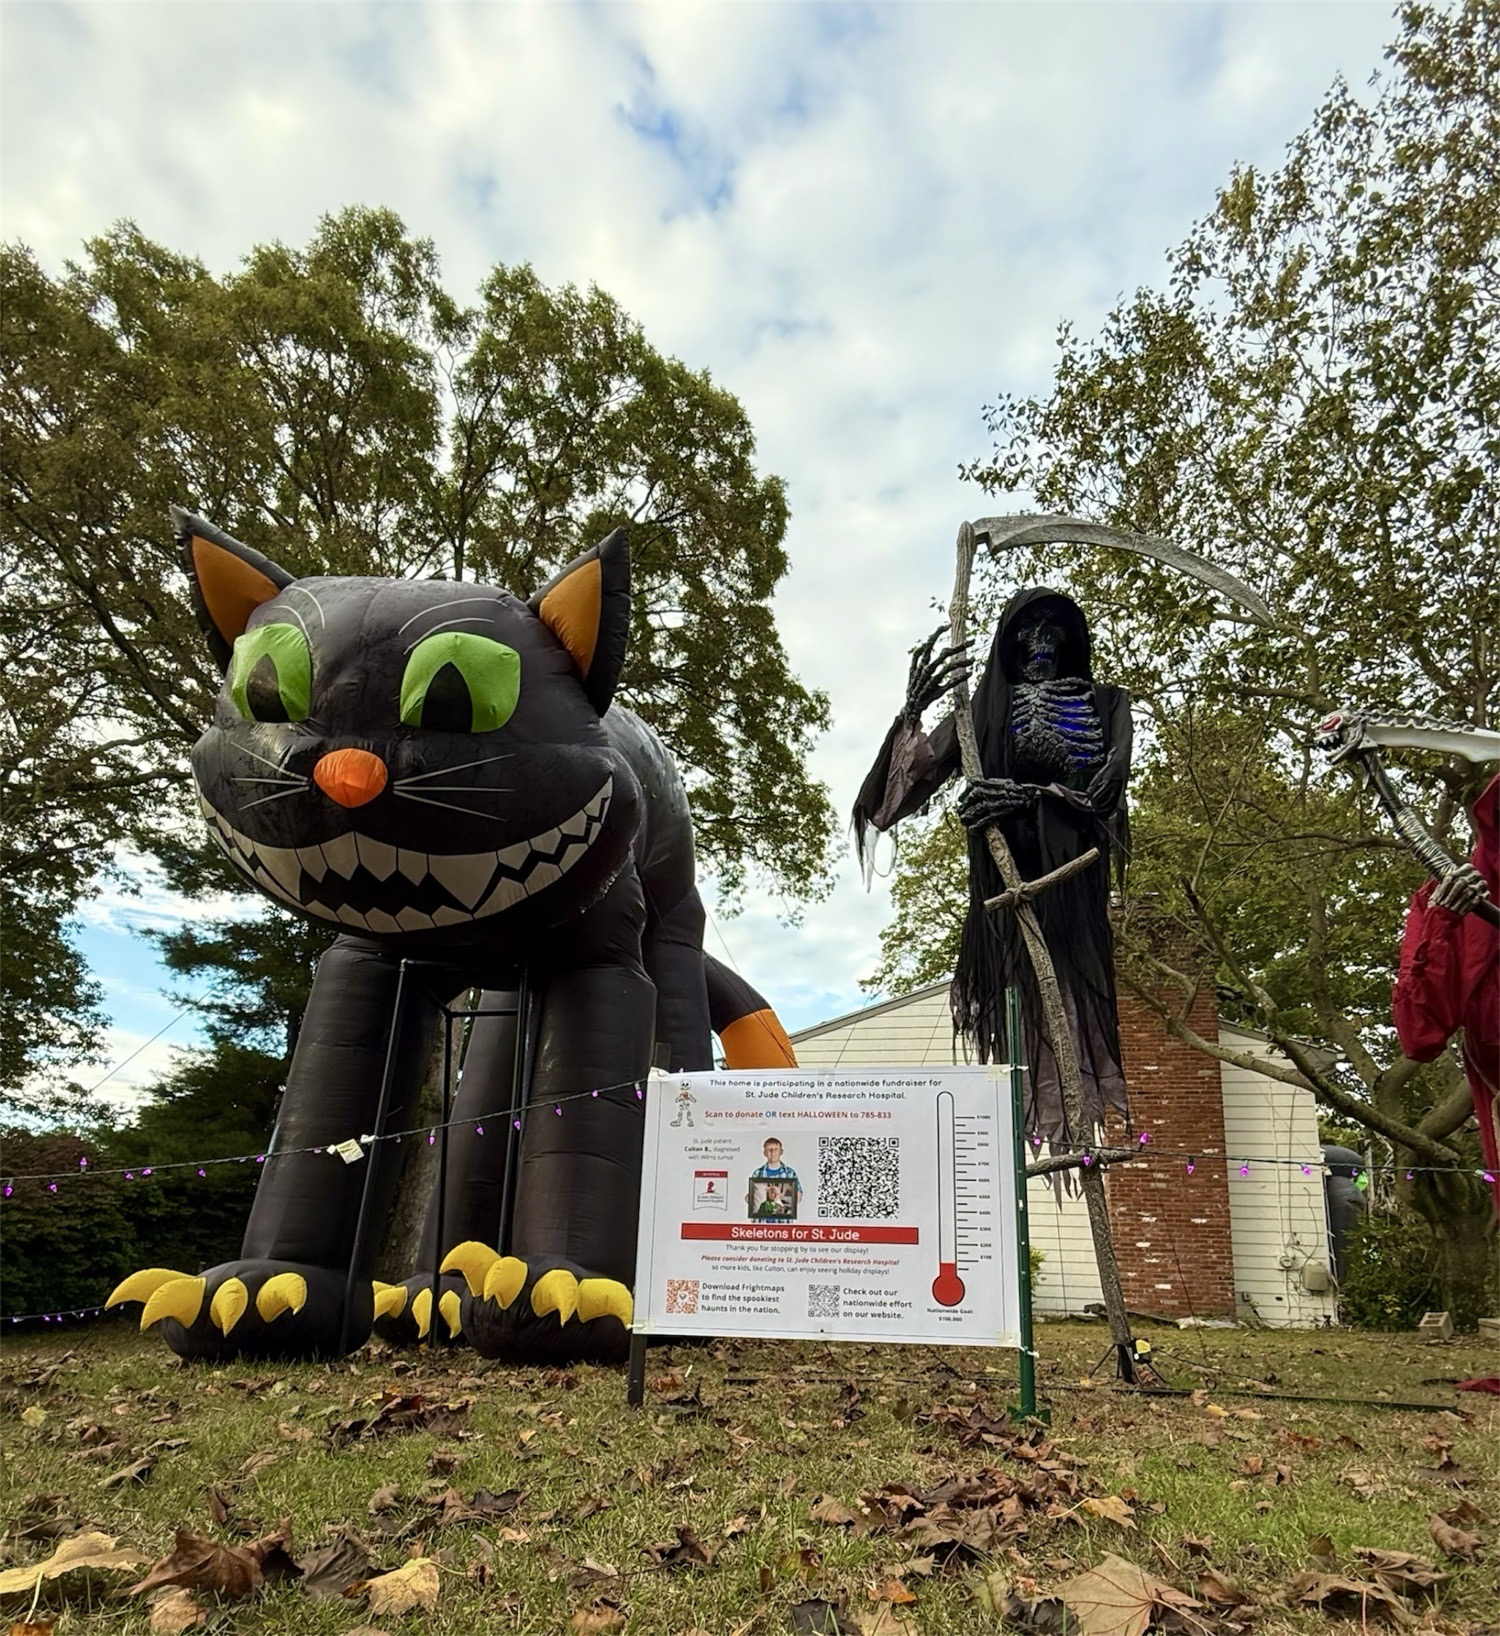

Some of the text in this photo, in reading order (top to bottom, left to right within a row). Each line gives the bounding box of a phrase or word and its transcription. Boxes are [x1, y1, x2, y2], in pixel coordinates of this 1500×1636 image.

[763, 1080, 815, 1088] participating
[731, 1226, 860, 1240] Skeletons for St. Jude
[742, 1284, 785, 1293] Frightmaps
[743, 1296, 779, 1304] spookiest
[843, 1299, 912, 1308] nationwide effort
[870, 1311, 904, 1319] website.
